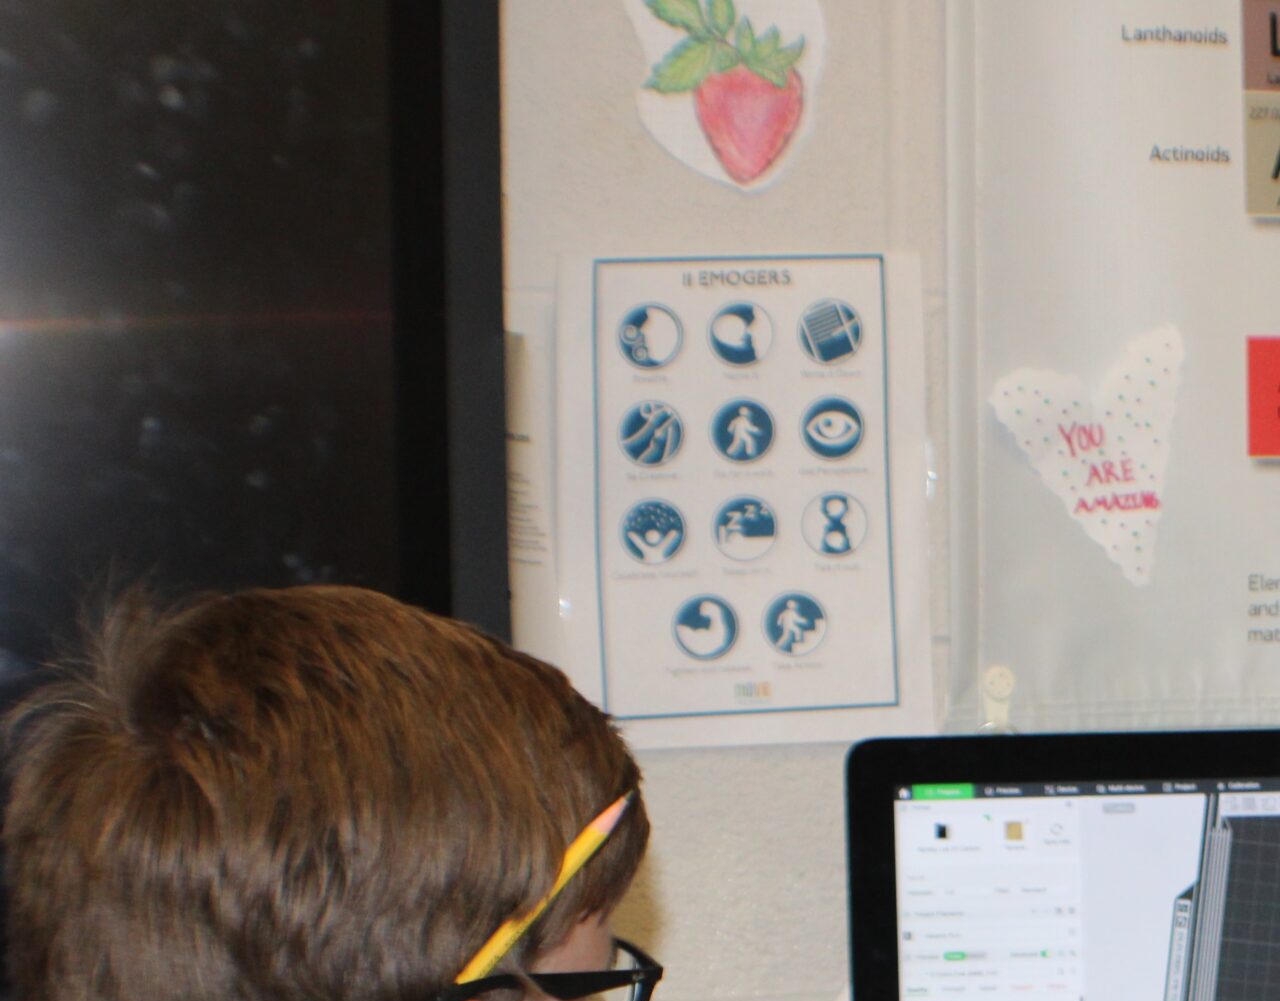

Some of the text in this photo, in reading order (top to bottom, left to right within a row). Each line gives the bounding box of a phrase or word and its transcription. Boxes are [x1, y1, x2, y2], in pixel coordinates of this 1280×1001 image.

[1121, 24, 1228, 44] Lanthanoids
[1150, 144, 1231, 163] Actinoids
[699, 269, 793, 287] EMOGERS
[1057, 420, 1105, 458] YOU
[1085, 457, 1136, 486] ARE
[1248, 600, 1279, 616] and
